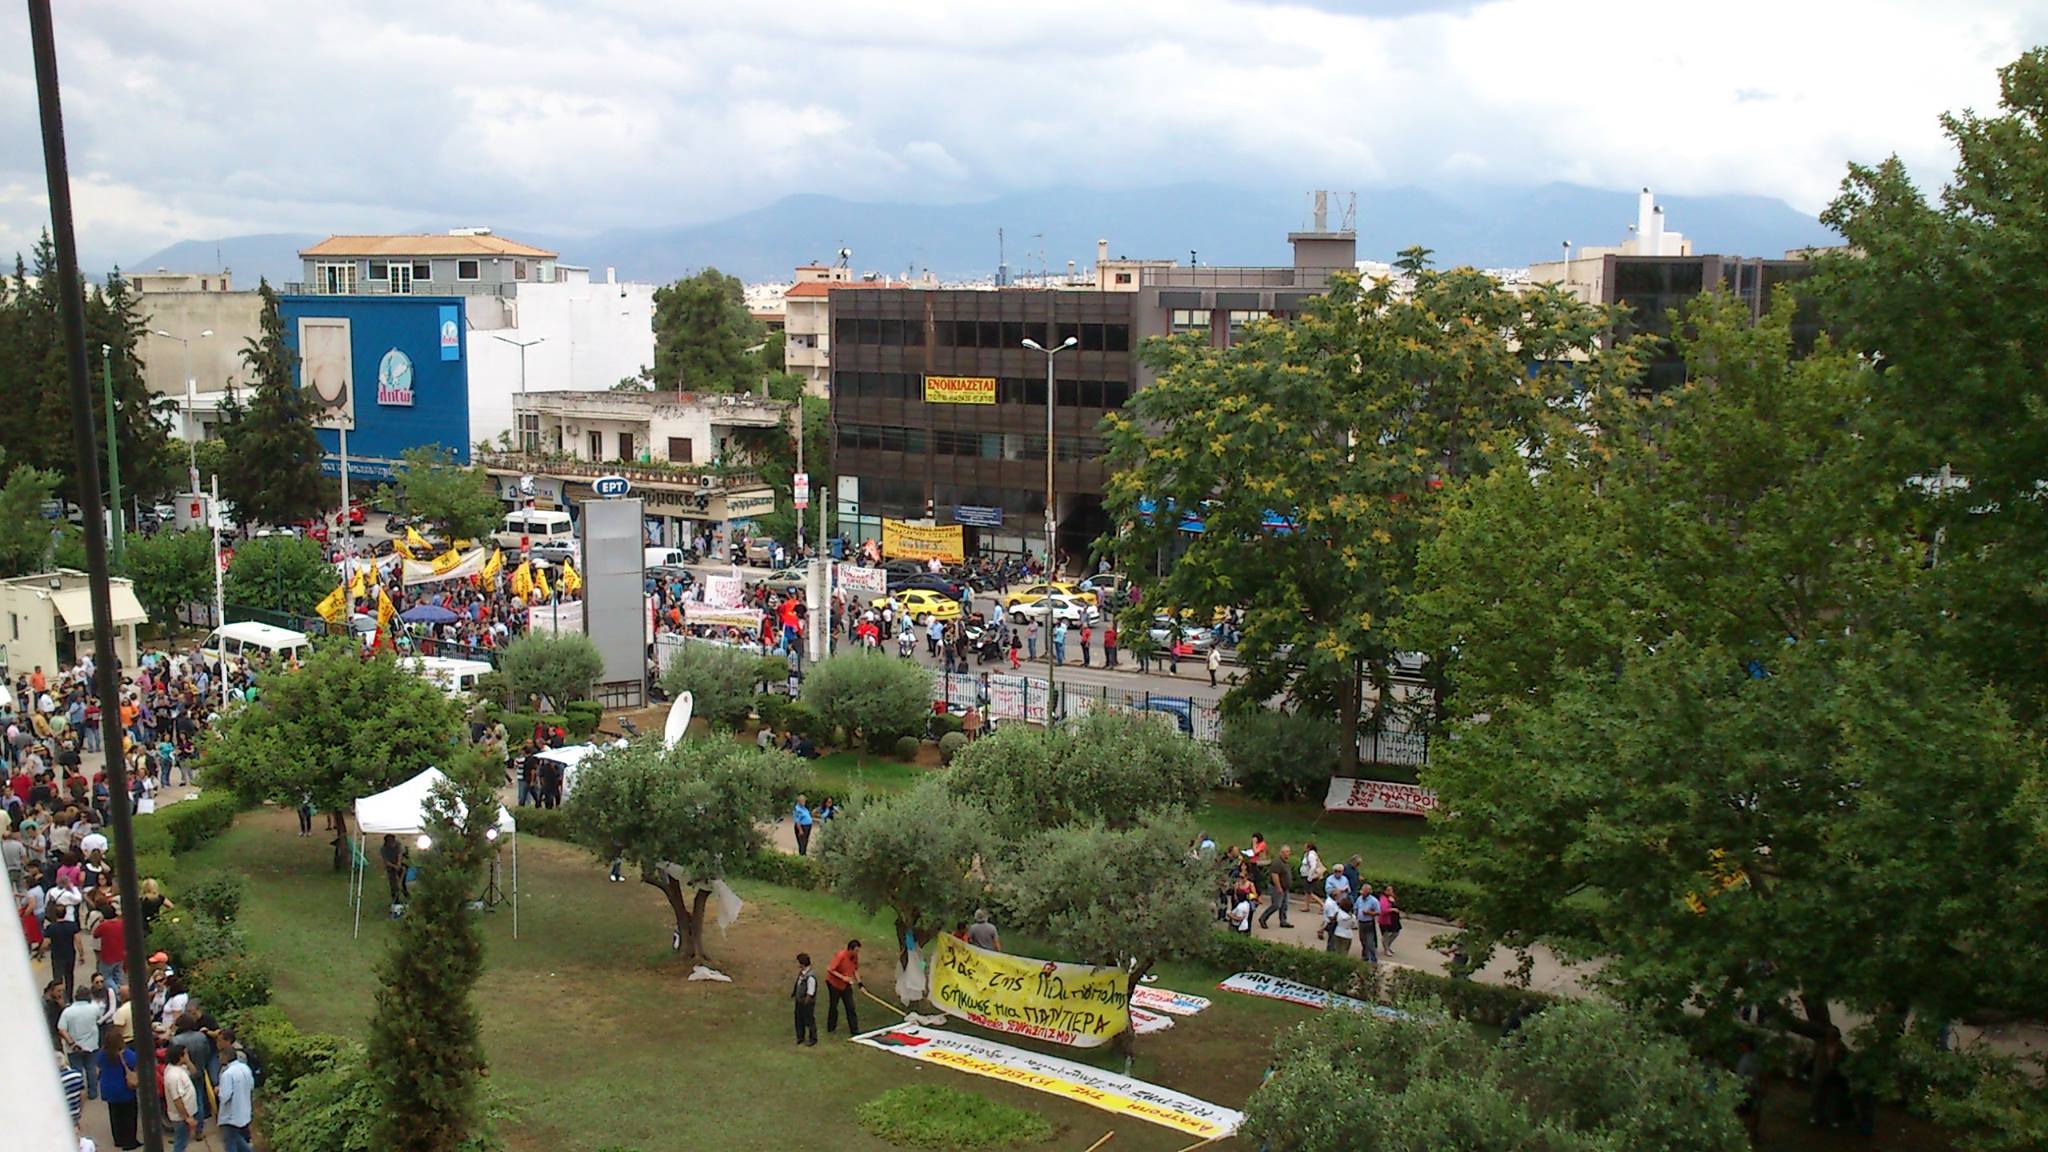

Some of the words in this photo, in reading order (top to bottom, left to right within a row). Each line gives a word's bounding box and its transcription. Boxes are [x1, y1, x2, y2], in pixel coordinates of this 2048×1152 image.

[928, 379, 993, 391] ΕΝΟΙΚΙΑΖΕΤΑΙ
[602, 480, 624, 493] ΕΡΤ
[1023, 1000, 1111, 1034] ΠΑΝΤΙΕΡΑ
[1127, 1103, 1214, 1132] ΑΝΑΤΡΟΠΗ
